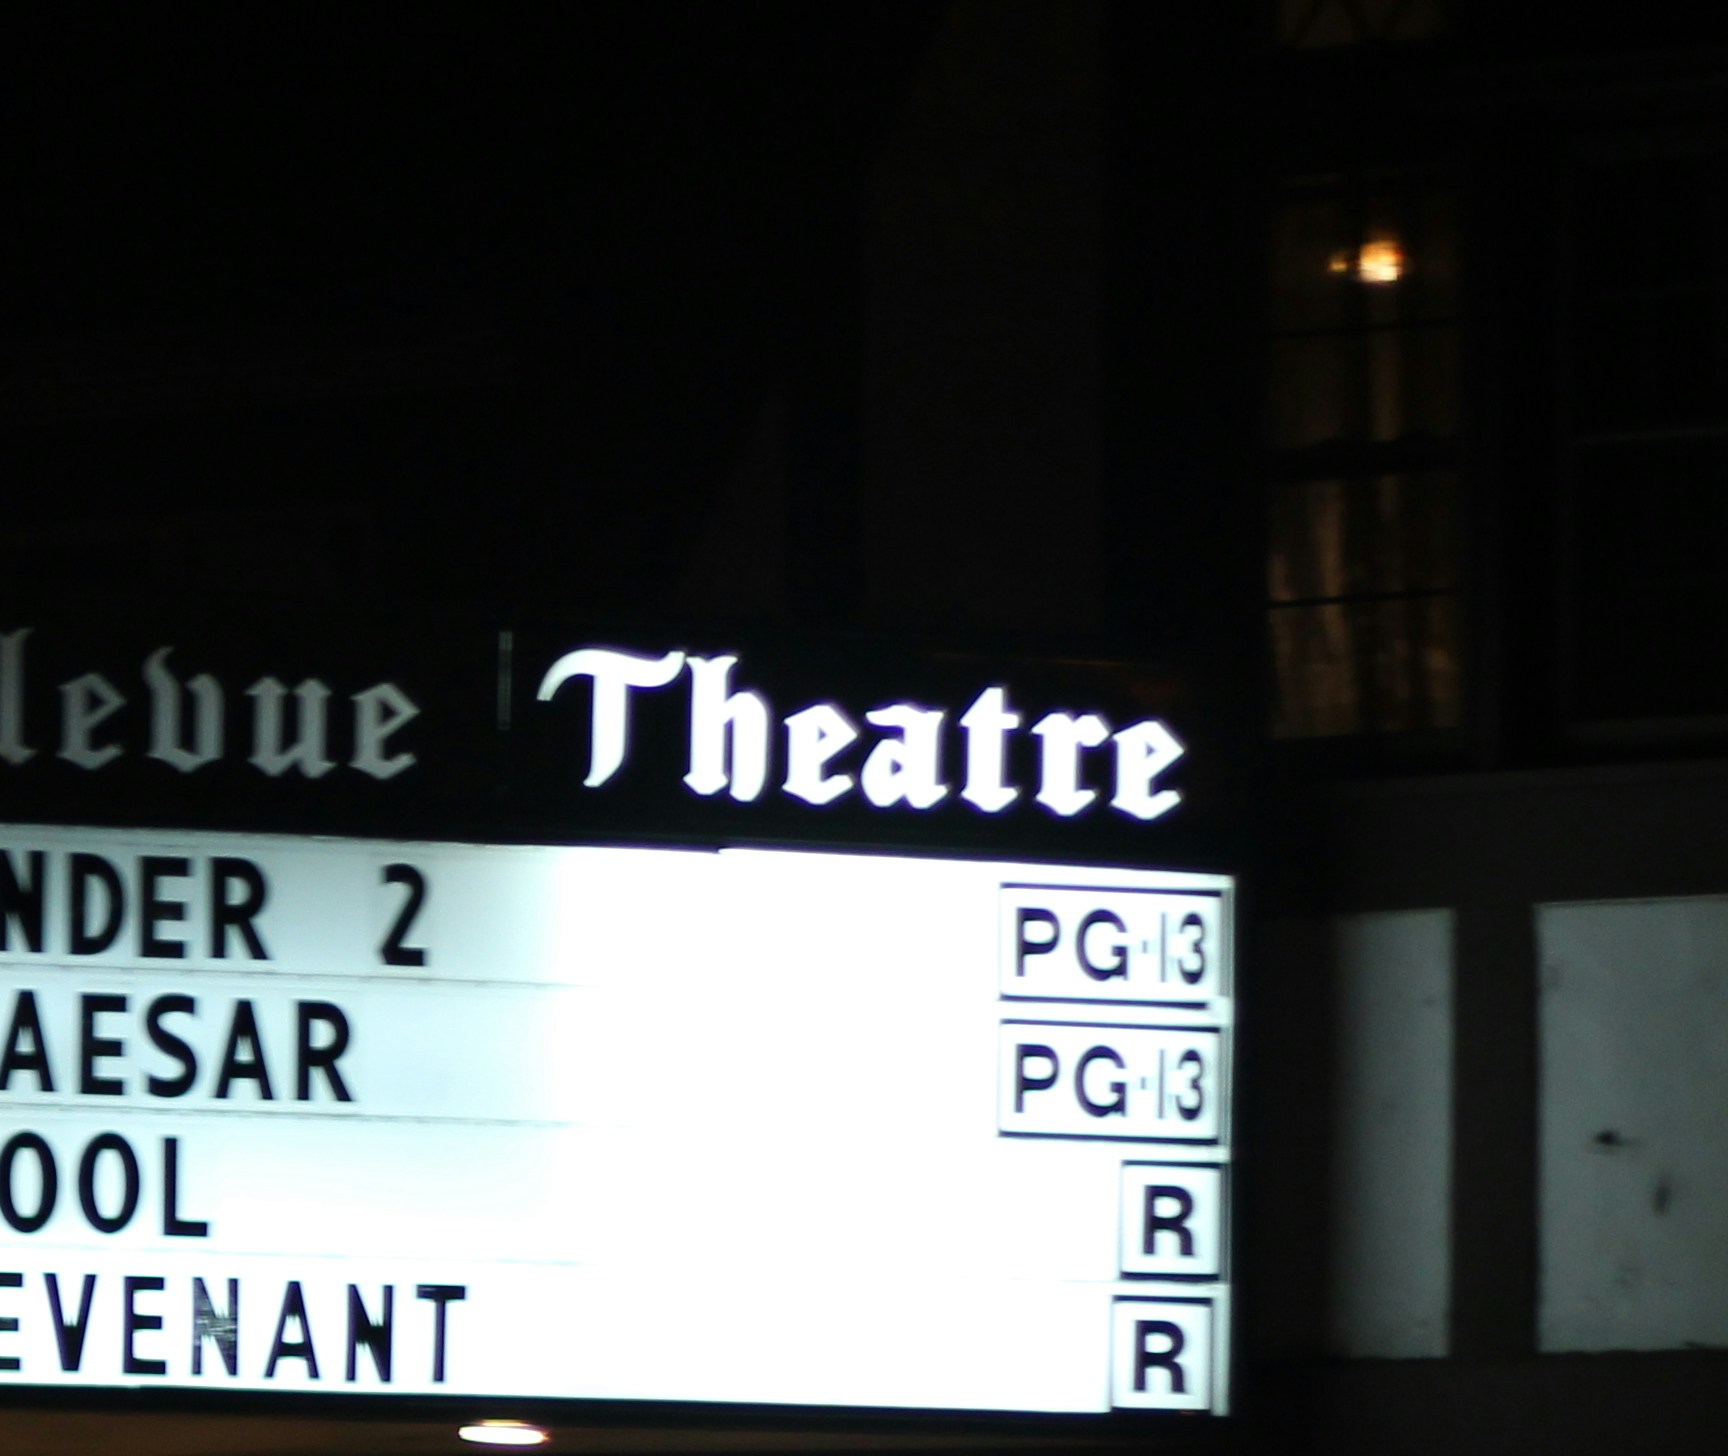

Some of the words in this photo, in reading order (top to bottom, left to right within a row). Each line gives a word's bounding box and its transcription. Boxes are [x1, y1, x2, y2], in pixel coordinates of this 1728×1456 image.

[538, 648, 1187, 820] Theatre
[380, 863, 429, 966] 2
[1143, 1184, 1195, 1256] R
[1133, 1319, 1187, 1393] R
